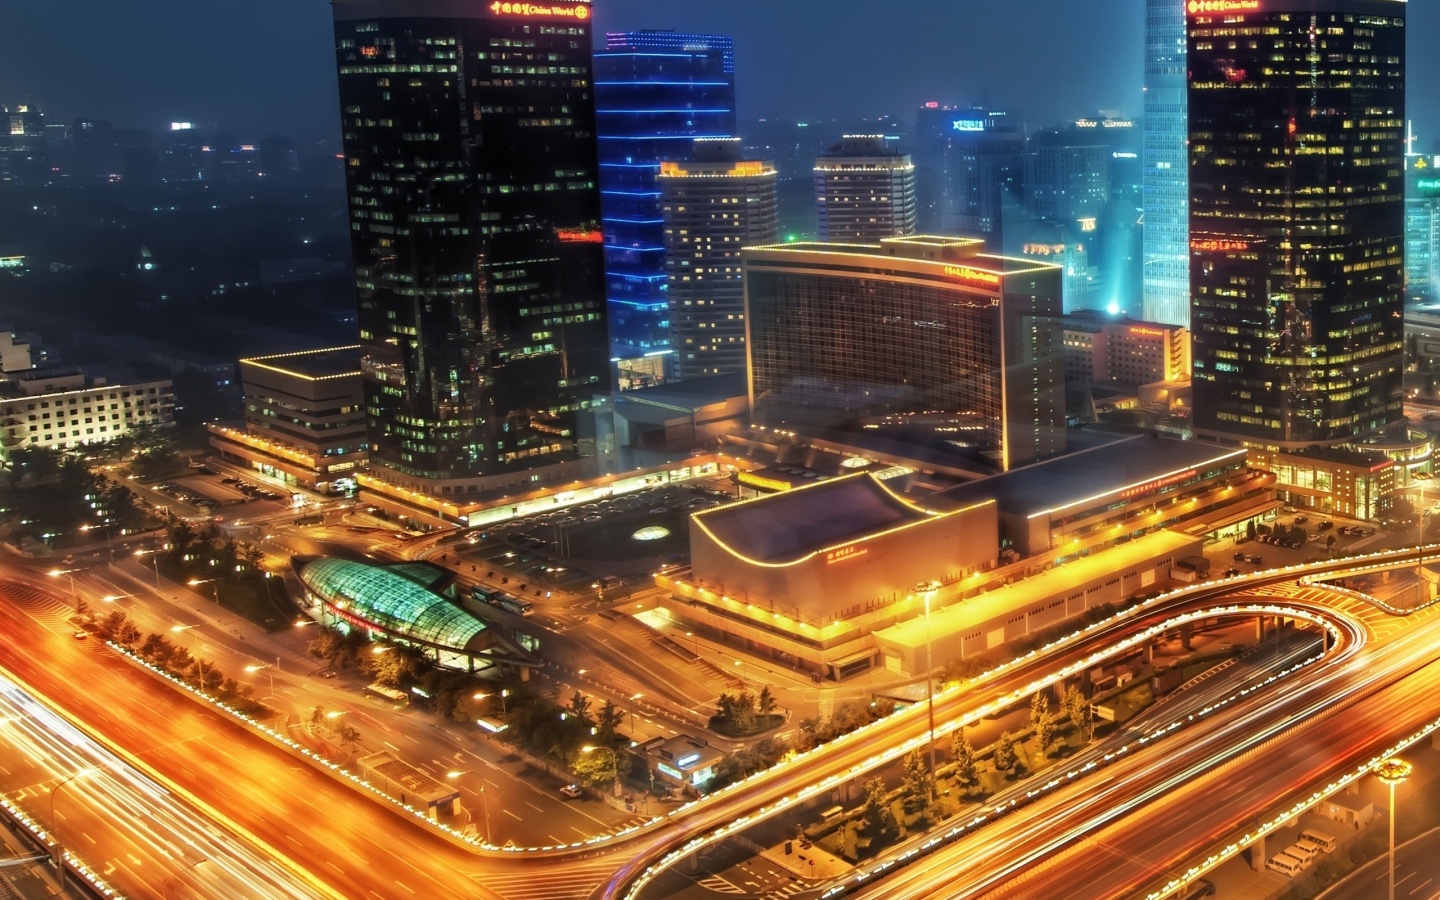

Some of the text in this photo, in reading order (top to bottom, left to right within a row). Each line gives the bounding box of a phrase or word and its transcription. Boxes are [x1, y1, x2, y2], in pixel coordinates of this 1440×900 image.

[1225, 1, 1241, 9] China
[1241, 0, 1258, 8] World
[529, 6, 551, 15] China
[552, 7, 574, 16] World
